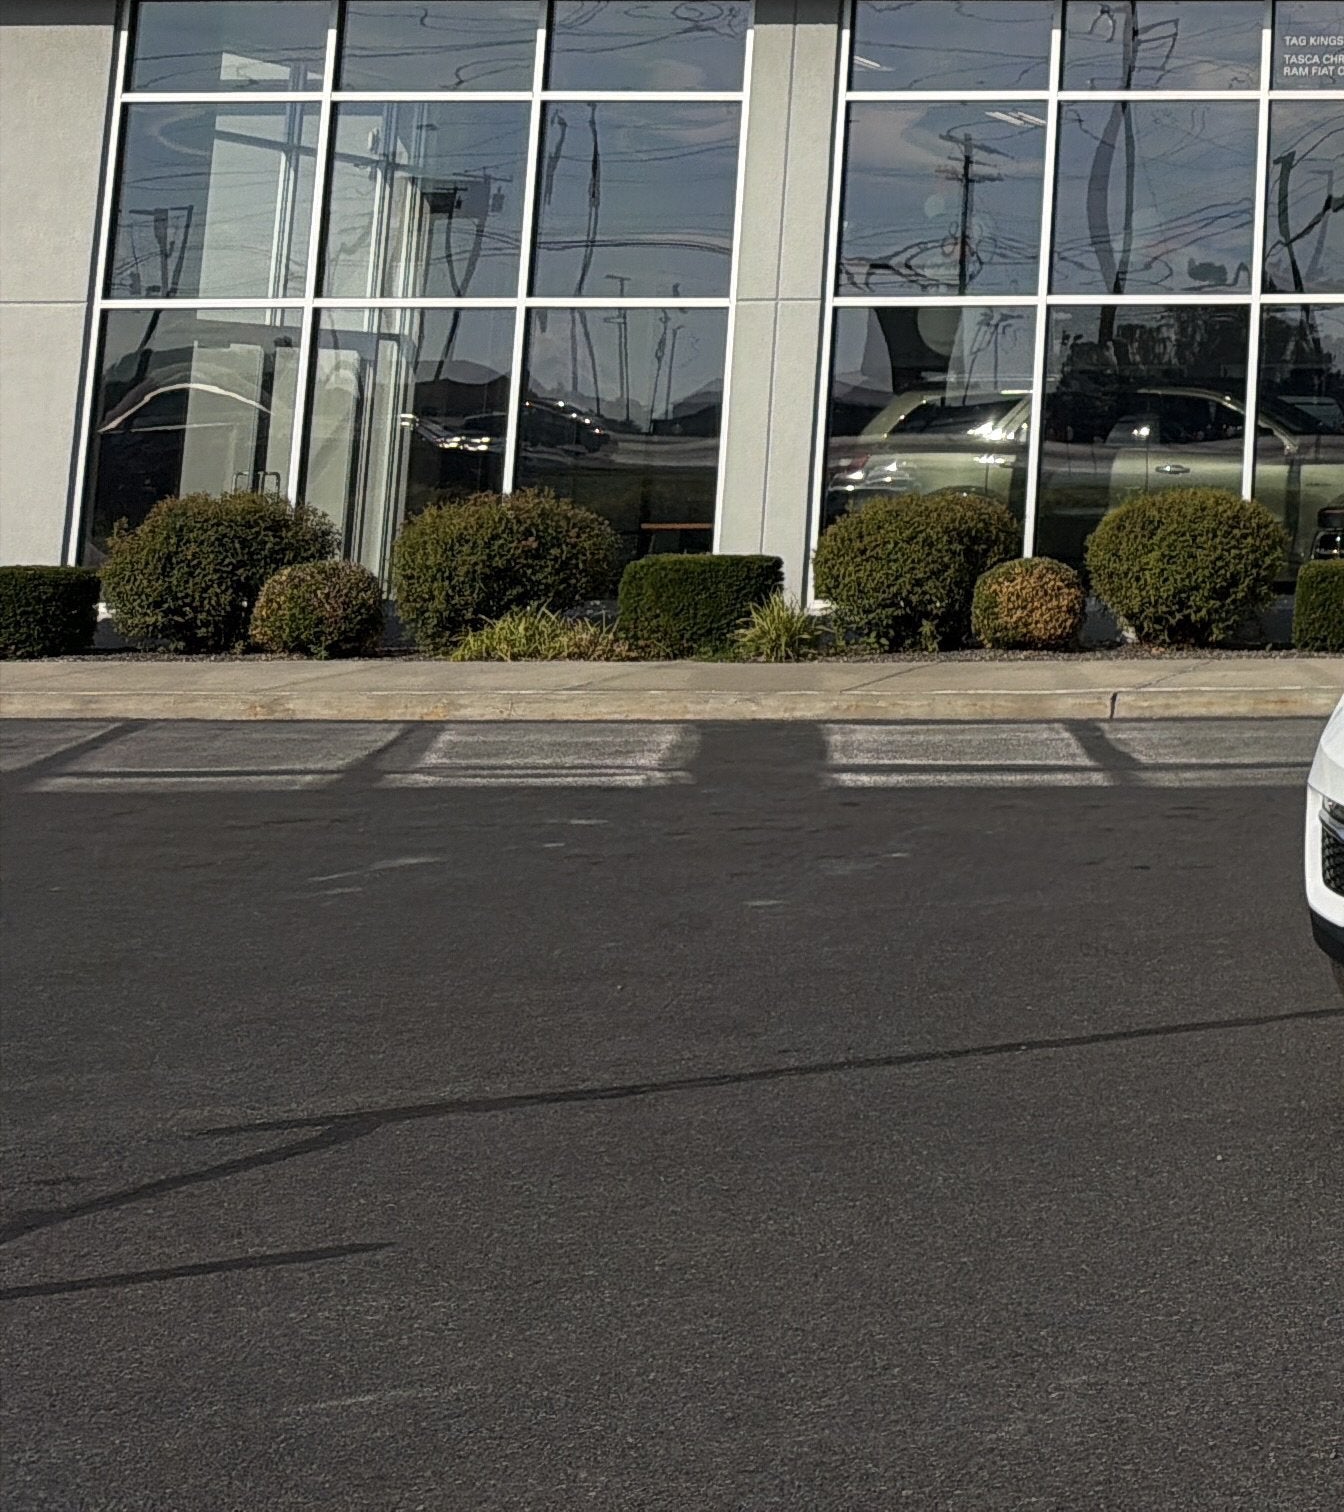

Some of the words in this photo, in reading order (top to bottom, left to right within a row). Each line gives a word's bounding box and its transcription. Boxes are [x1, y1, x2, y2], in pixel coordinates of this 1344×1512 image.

[1284, 36, 1307, 46] TAG
[1283, 54, 1320, 64] TASCA
[1283, 66, 1308, 76] RAM
[1311, 66, 1334, 76] FIAT
